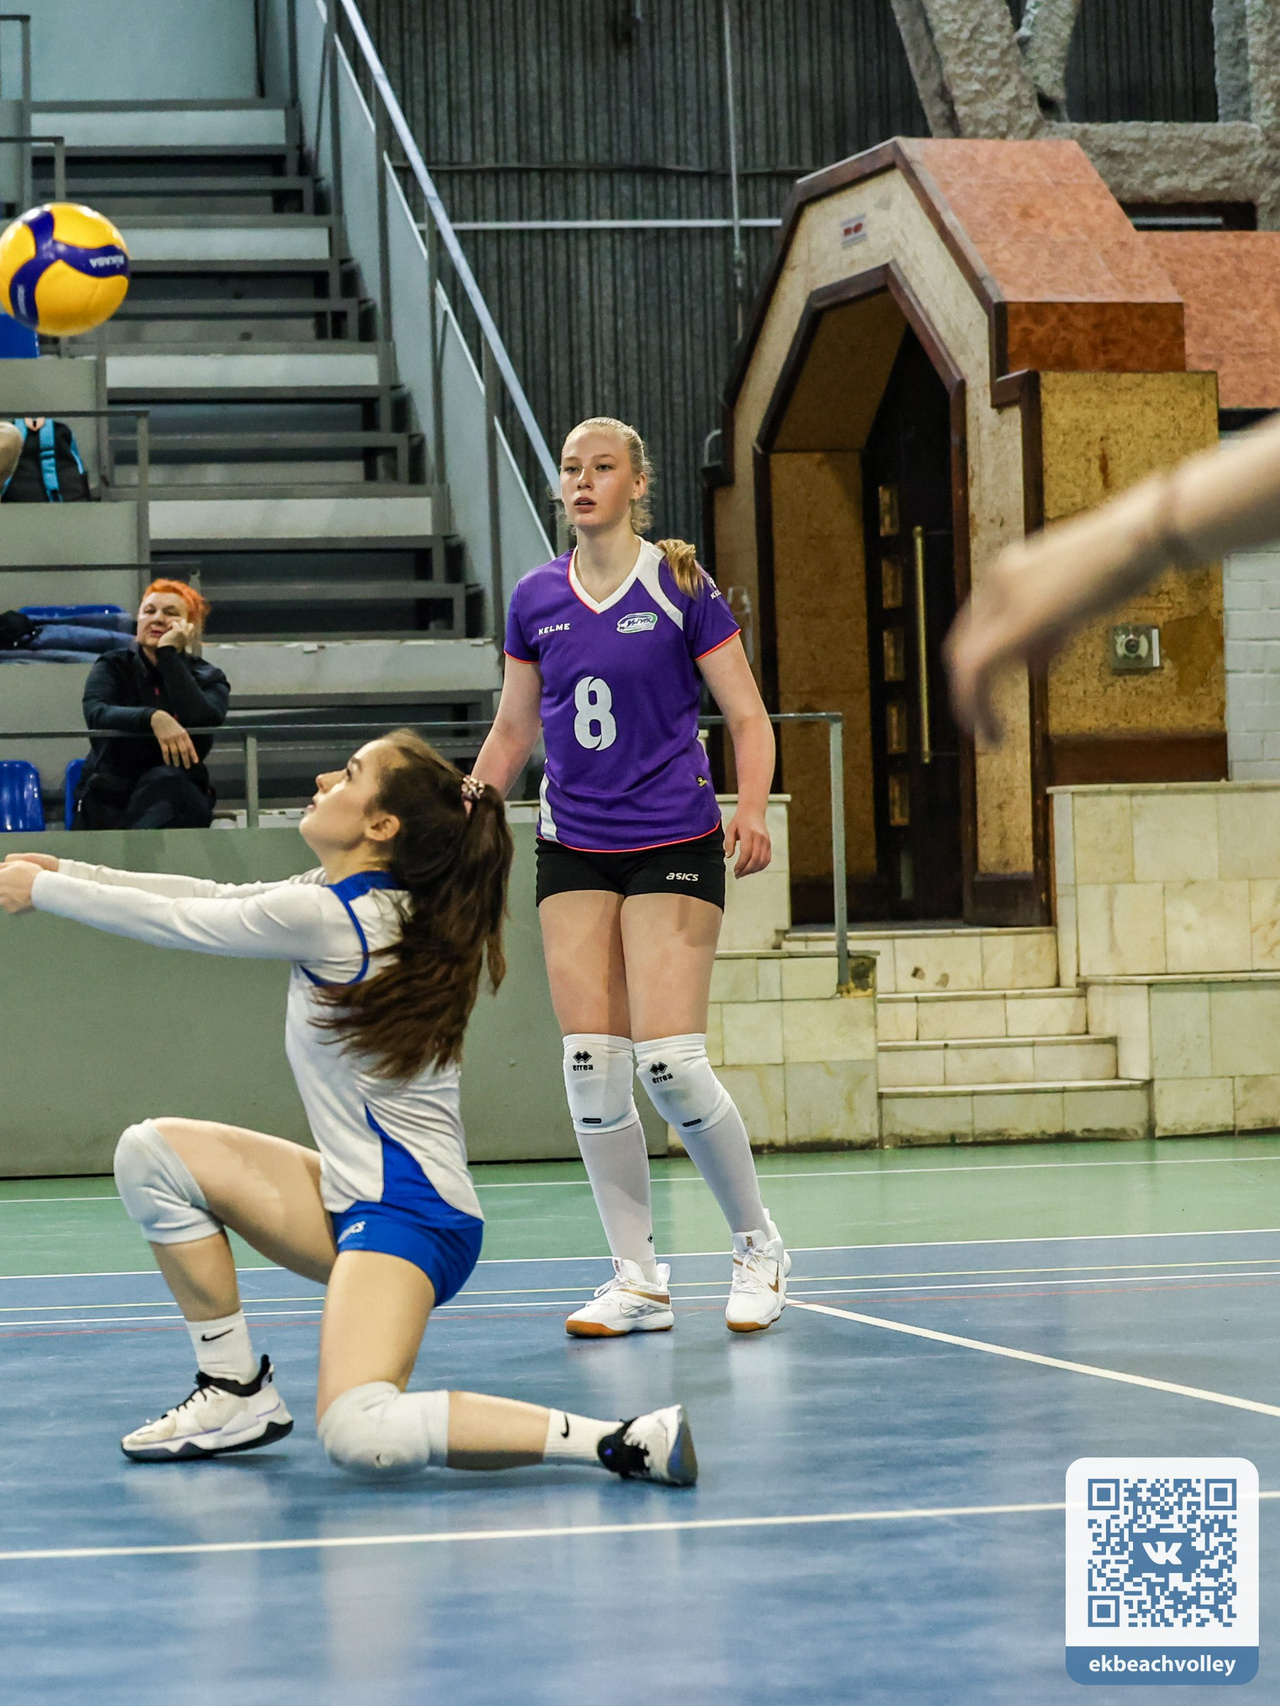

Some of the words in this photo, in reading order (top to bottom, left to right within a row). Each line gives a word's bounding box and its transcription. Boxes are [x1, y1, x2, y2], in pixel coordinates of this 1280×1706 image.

[538, 622, 571, 636] KELME
[574, 676, 617, 751] 8
[666, 872, 699, 882] asics
